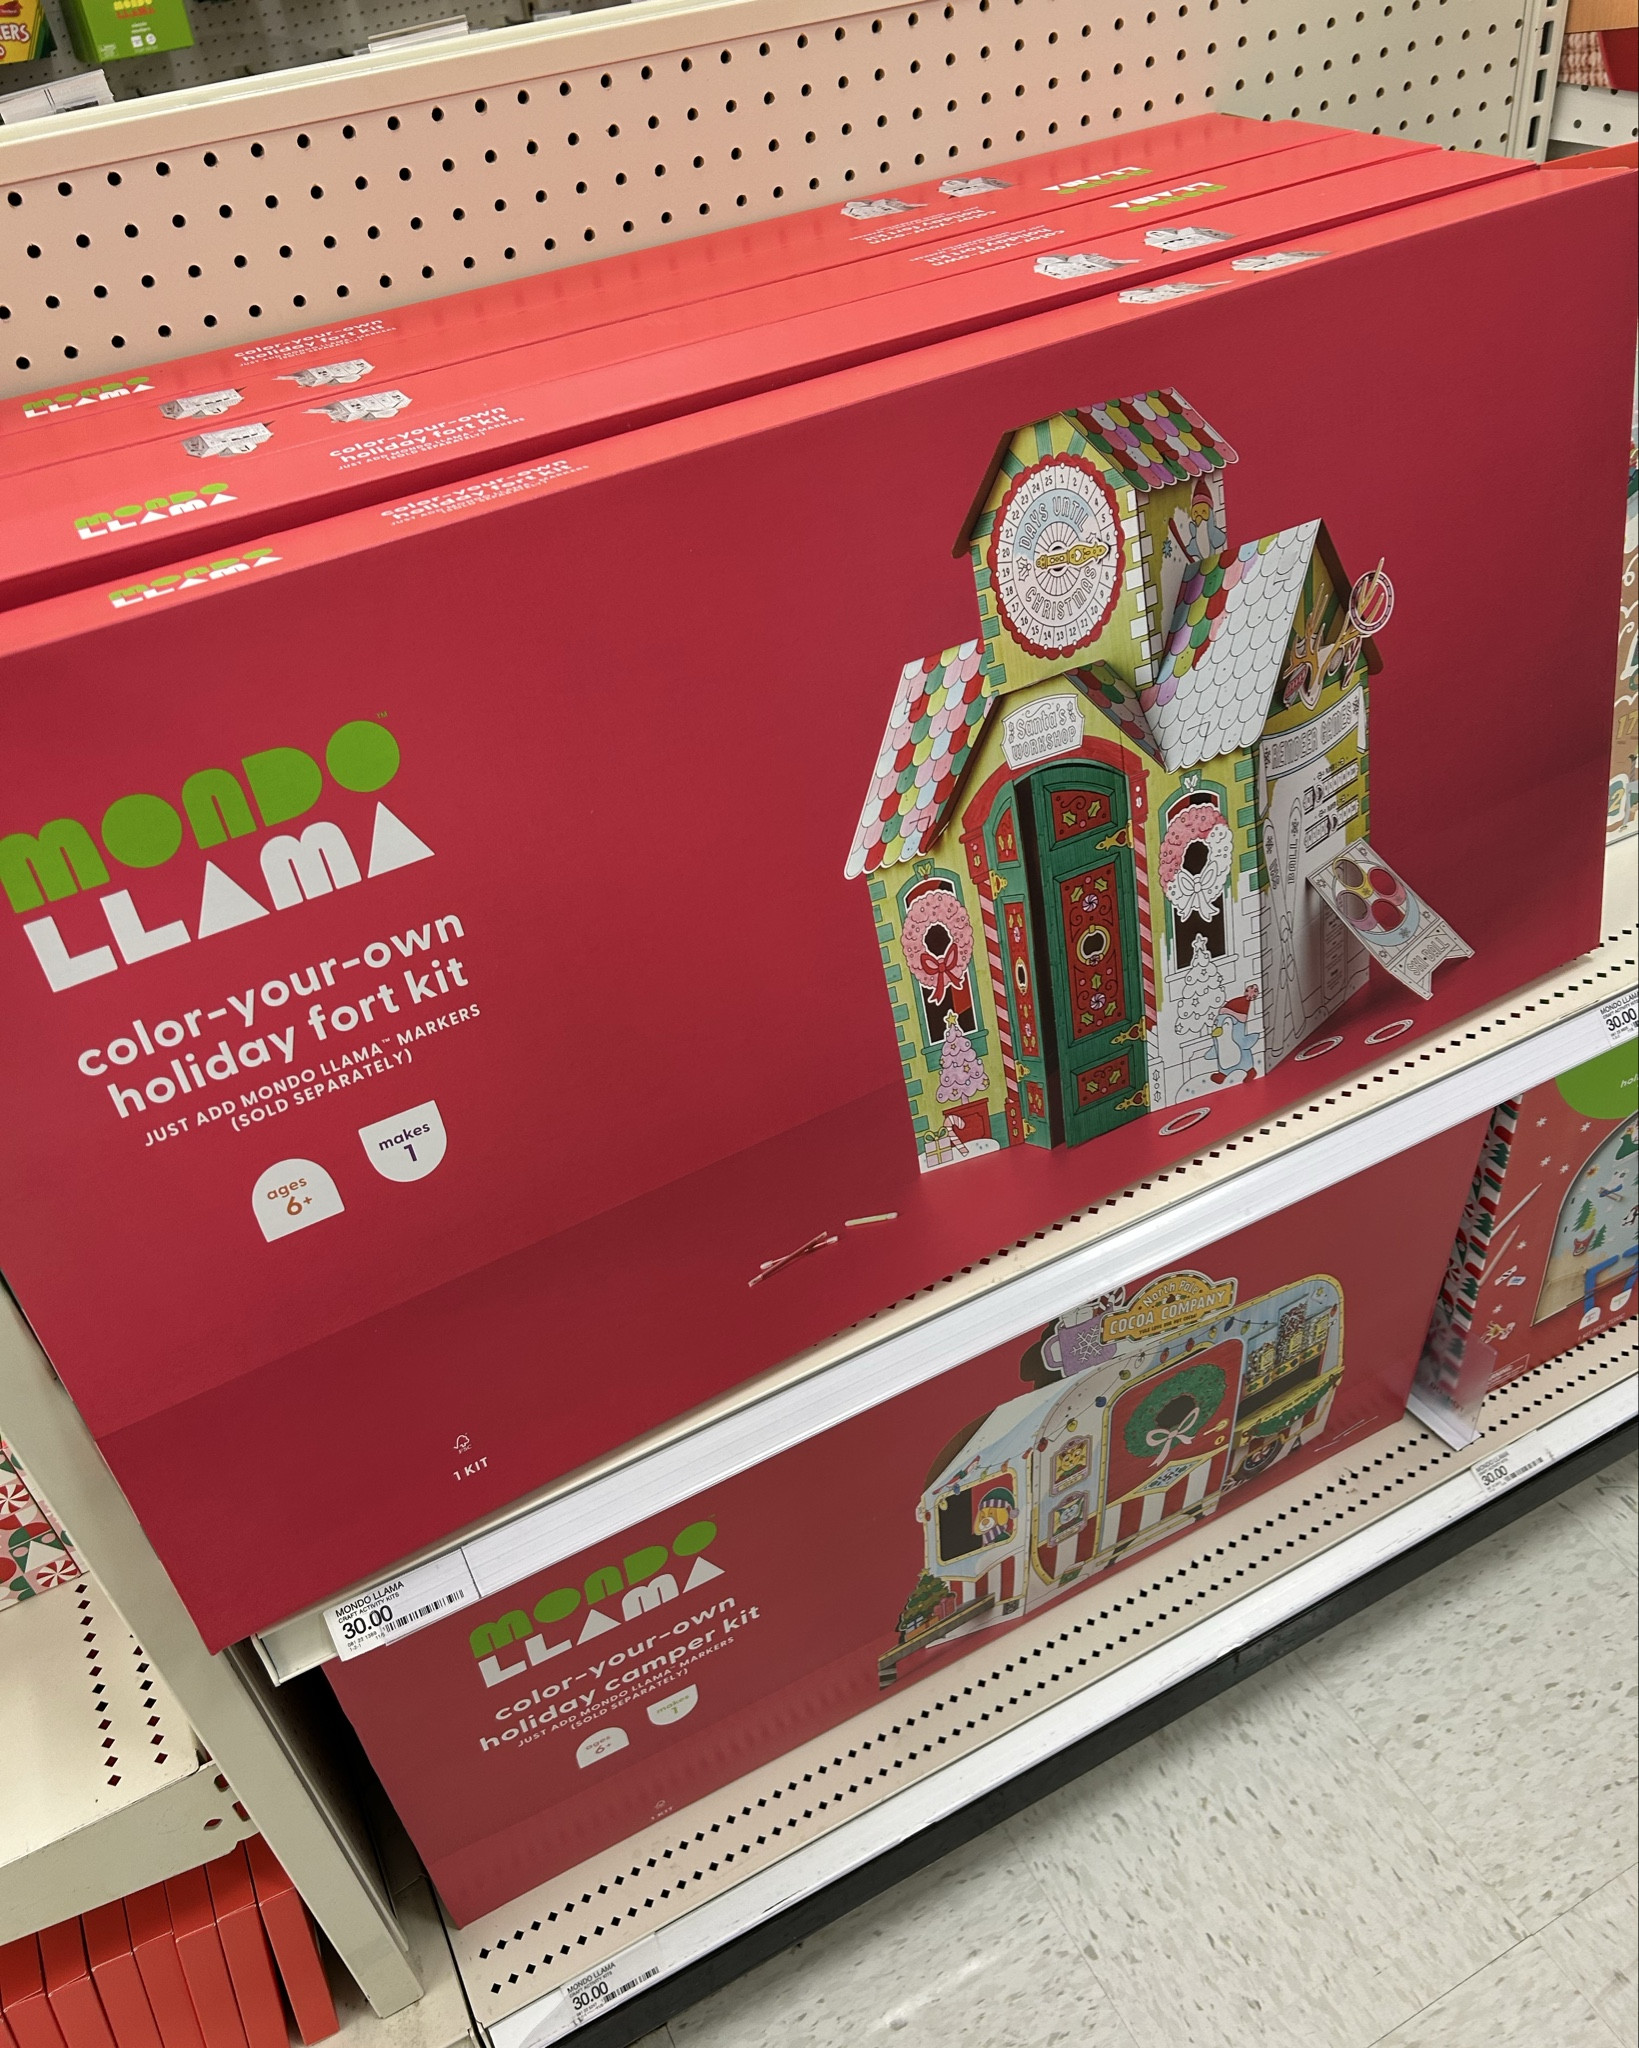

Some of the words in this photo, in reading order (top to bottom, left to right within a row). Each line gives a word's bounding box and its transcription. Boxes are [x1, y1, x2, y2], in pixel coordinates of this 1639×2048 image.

[0, 23, 30, 42] ERS
[234, 319, 383, 358] color-your-own
[242, 341, 315, 362] holiday
[321, 331, 357, 343] fort
[357, 324, 385, 334] kit
[22, 376, 149, 411] MONDO
[24, 383, 155, 418] LLAMA
[329, 407, 506, 458] color-your-own
[340, 434, 427, 463] holiday
[433, 422, 477, 438] fort
[479, 412, 510, 428] kit
[338, 461, 362, 470] JUST
[1045, 475, 1053, 486] 25
[380, 459, 568, 517] color-your-own
[392, 490, 485, 521] holiday
[490, 474, 535, 491] fort
[537, 463, 573, 480] kit
[1021, 494, 1029, 504] 23
[1032, 483, 1040, 493] 24
[74, 482, 229, 529] MONDO
[77, 493, 239, 540] LLAMA
[1012, 510, 1020, 520] 22
[1005, 527, 1013, 537] 21
[1019, 502, 1049, 551] DAYS
[1051, 495, 1090, 533] UNTIL
[1003, 548, 1010, 558] 20
[108, 547, 273, 602] MONDO
[111, 555, 284, 608] LLAMA
[1003, 567, 1010, 577] 19
[1005, 586, 1013, 596] 18
[1012, 602, 1020, 613] 17
[1025, 565, 1097, 621] CHRISTMAS
[1021, 615, 1028, 626] 16
[1081, 618, 1088, 628] 11
[1091, 605, 1098, 615] 10
[1032, 625, 1039, 636] 15
[1044, 629, 1051, 640] 14
[1057, 630, 1064, 641] 13
[1069, 627, 1076, 637] 12
[1016, 703, 1067, 740] Santa's
[1011, 725, 1077, 761] WORKSHOP
[1271, 726, 1318, 769] REINDEER
[0, 719, 400, 914] MONDO
[23, 801, 436, 993] LLAMA
[77, 914, 466, 1077] color-your-own
[1605, 1007, 1637, 1032] 30.00
[107, 1026, 295, 1119] holiday
[307, 983, 400, 1042] fort
[404, 957, 469, 1004] kit
[144, 1117, 190, 1148] JUST
[195, 1100, 236, 1127] ADD
[240, 1068, 316, 1109] MONDO
[396, 1003, 481, 1046] MARKERS
[231, 1101, 290, 1132] (SOLD
[292, 1048, 413, 1106] SEPARATELY)
[1620, 1073, 1638, 1089] hol
[378, 1122, 431, 1152] makes
[403, 1144, 418, 1163] 1
[266, 1176, 308, 1202] ages
[286, 1194, 313, 1216] 6+
[1143, 1282, 1176, 1307] North
[1179, 1279, 1200, 1295] Pole
[1110, 1311, 1155, 1335] COCOA
[1161, 1290, 1226, 1321] COMPANY
[453, 1471, 462, 1481] 1
[464, 1456, 489, 1477] KIT
[1480, 1464, 1509, 1487] 30.00
[335, 1595, 371, 1618] MONDO
[372, 1580, 405, 1600] LLAMA
[469, 1520, 717, 1659] MONDO
[338, 1610, 358, 1624] CRAFT
[359, 1598, 385, 1614] ACTIVITY
[386, 1591, 400, 1602] KITS
[342, 1604, 393, 1640] 30.00
[478, 1556, 726, 1688] LLAMA
[494, 1596, 736, 1721] color-your-own
[479, 1689, 597, 1752] holiday
[605, 1629, 716, 1692] camper
[723, 1605, 761, 1634] kit
[518, 1729, 547, 1748] JUST
[551, 1714, 577, 1732] ADD
[580, 1689, 628, 1717] MONDO
[679, 1636, 735, 1669] MARKERS
[570, 1708, 608, 1731] (SOLD
[611, 1668, 689, 1710] SEPARATELY)
[656, 1694, 690, 1714] makes
[585, 1735, 611, 1751] ages
[567, 1974, 593, 1994] MONDO
[593, 1961, 617, 1979] LLAMA
[572, 1981, 609, 2011] 30.00
